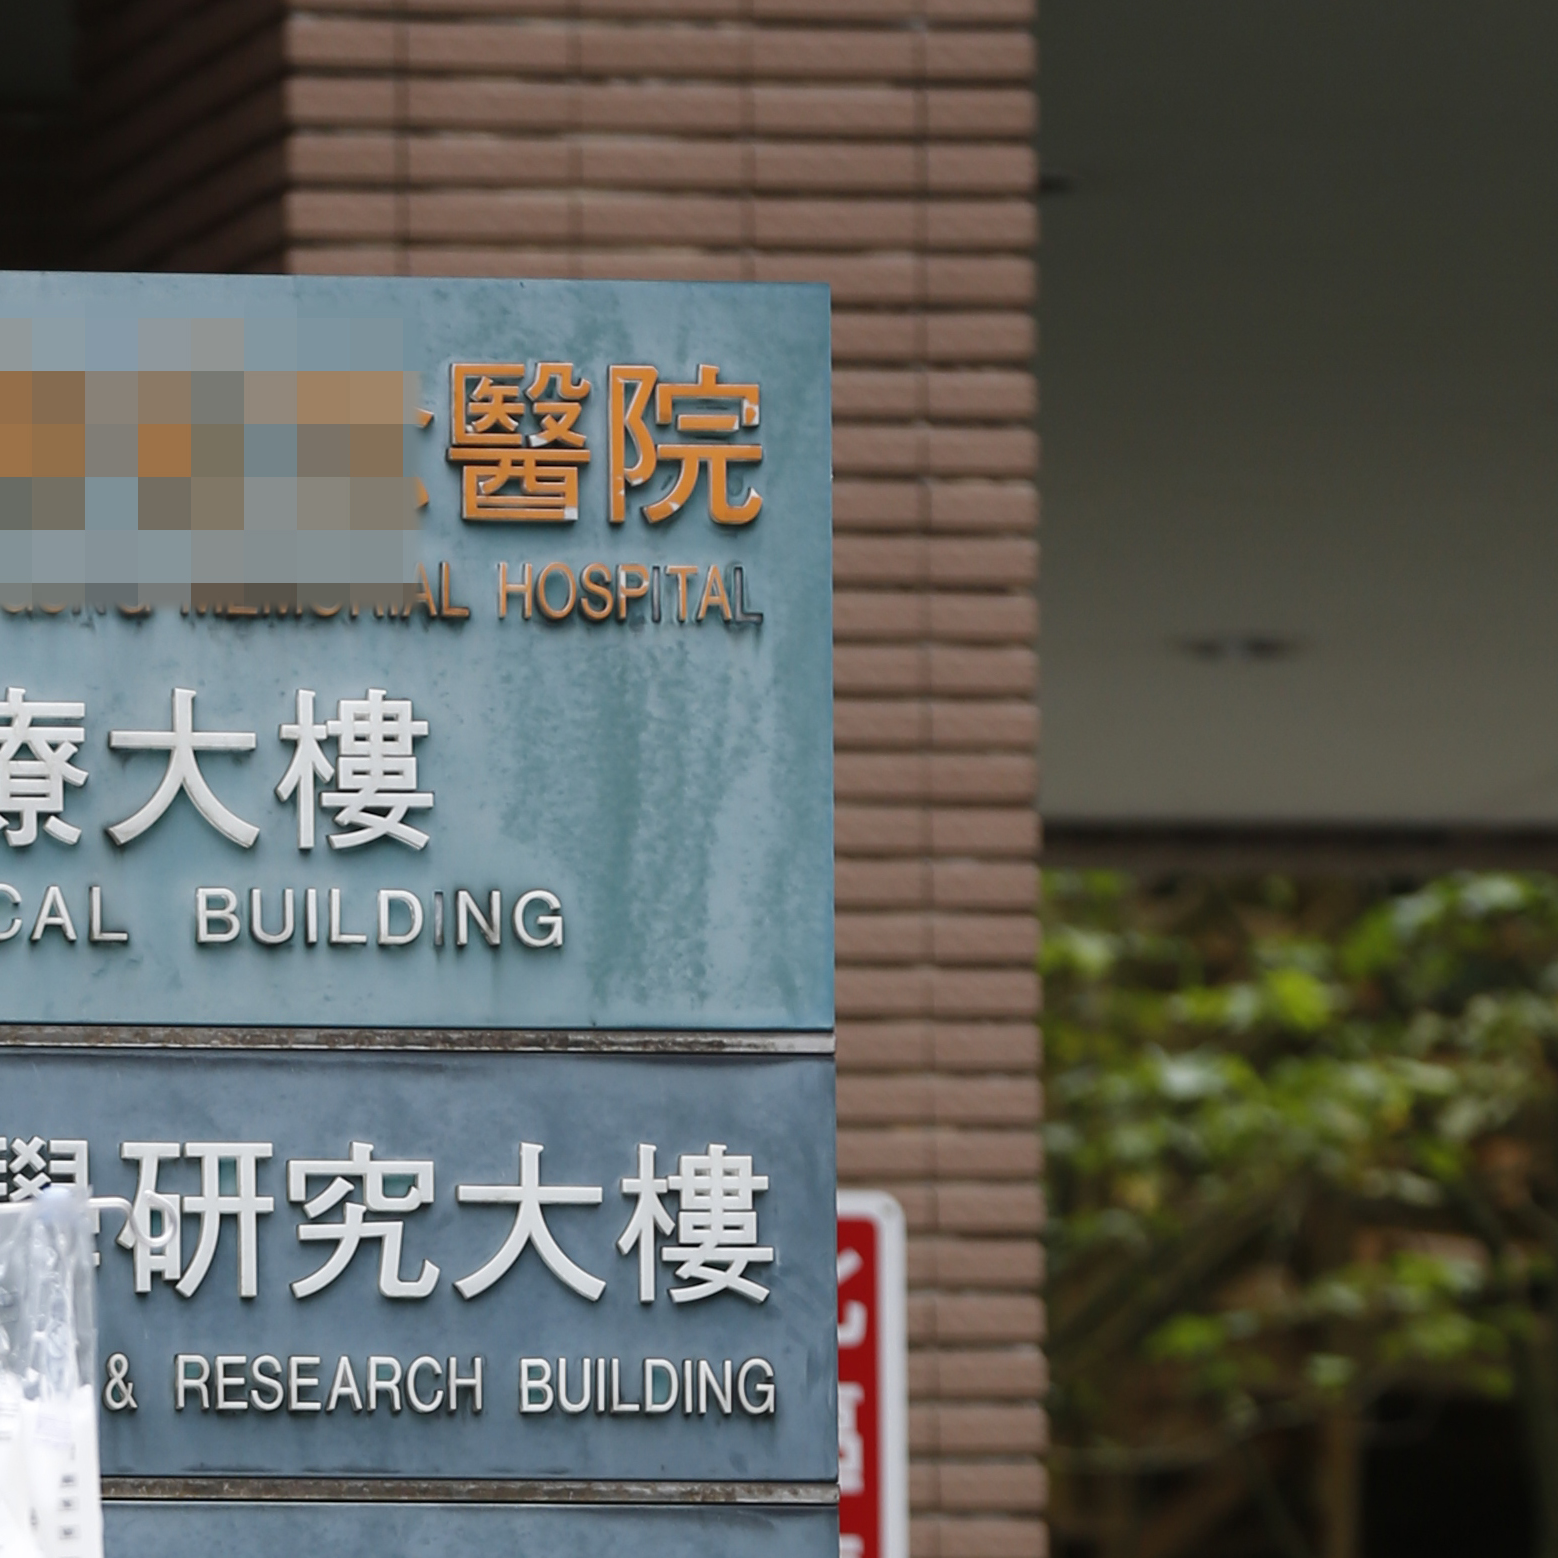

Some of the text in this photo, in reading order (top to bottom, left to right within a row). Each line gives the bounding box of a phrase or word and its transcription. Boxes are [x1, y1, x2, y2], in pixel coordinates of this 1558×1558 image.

[495, 561, 765, 622] HOSPITAL
[194, 886, 567, 949] BUILDING
[103, 1353, 778, 1415] & RESEARCH BUILDING
